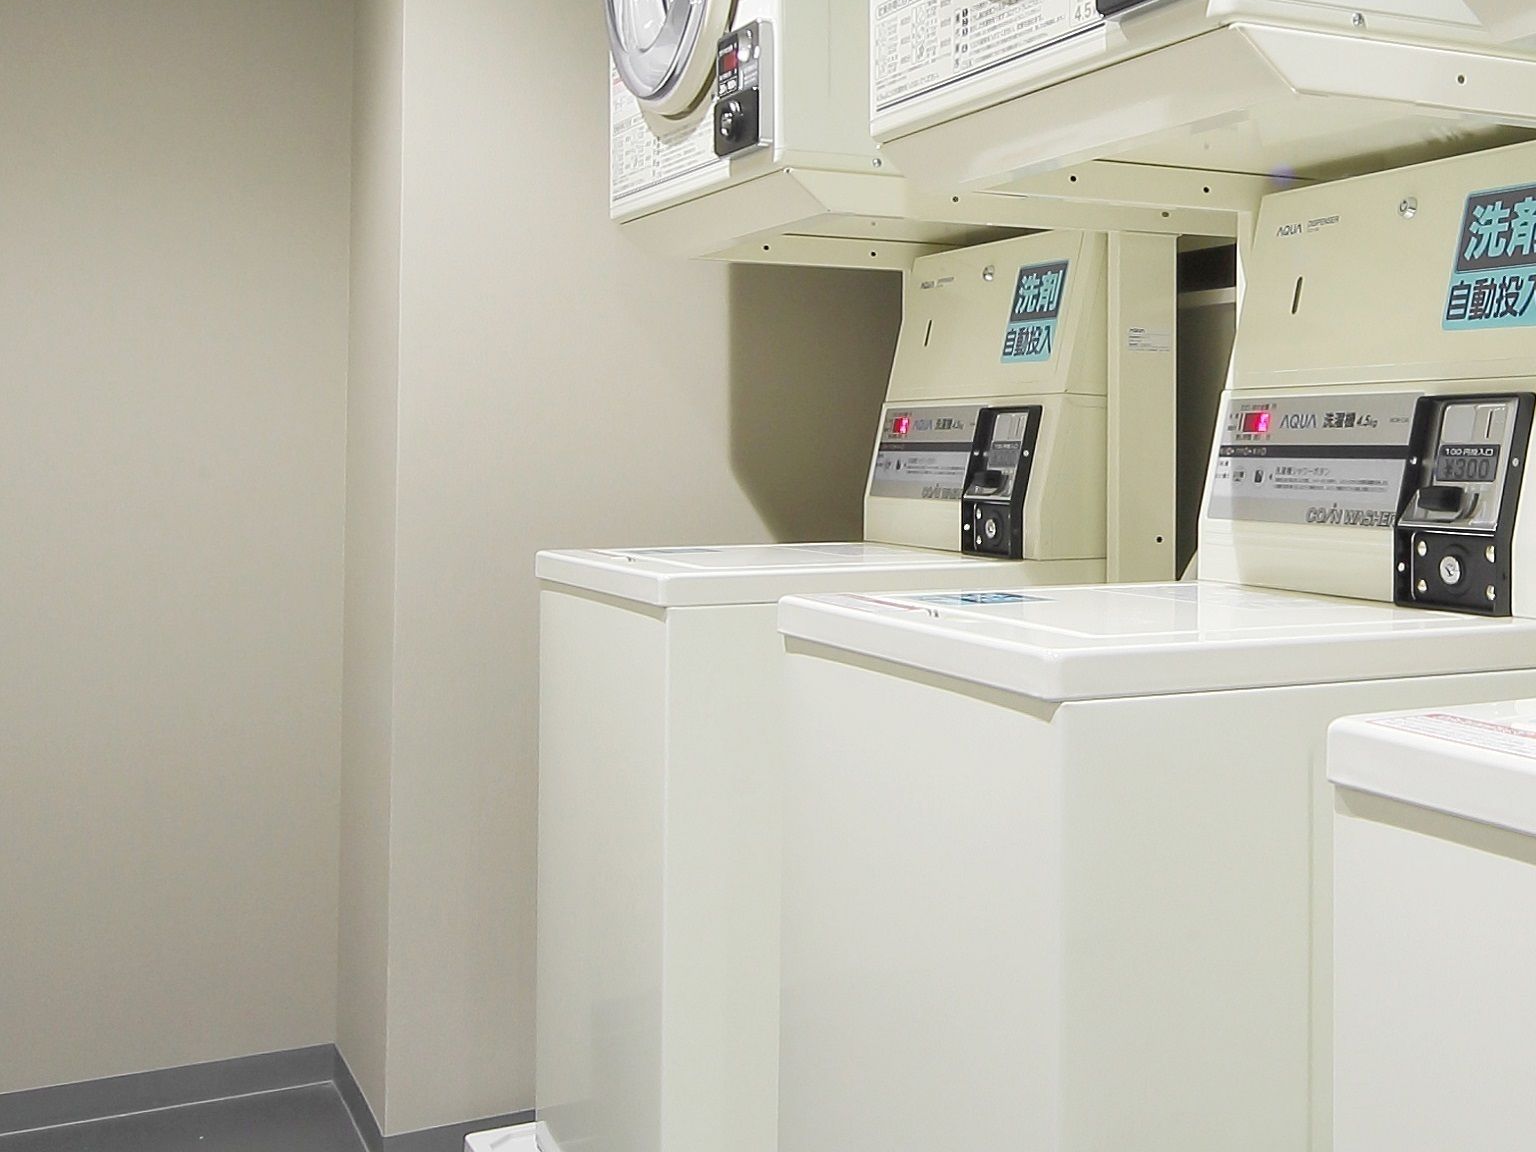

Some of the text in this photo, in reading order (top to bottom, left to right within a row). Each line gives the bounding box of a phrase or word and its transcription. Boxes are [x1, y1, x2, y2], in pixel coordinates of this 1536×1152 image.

[1014, 269, 1063, 314] 洗剤
[1003, 325, 1052, 357] 自動投入
[1280, 414, 1317, 429] AQUA
[1443, 458, 1490, 479] ¥300
